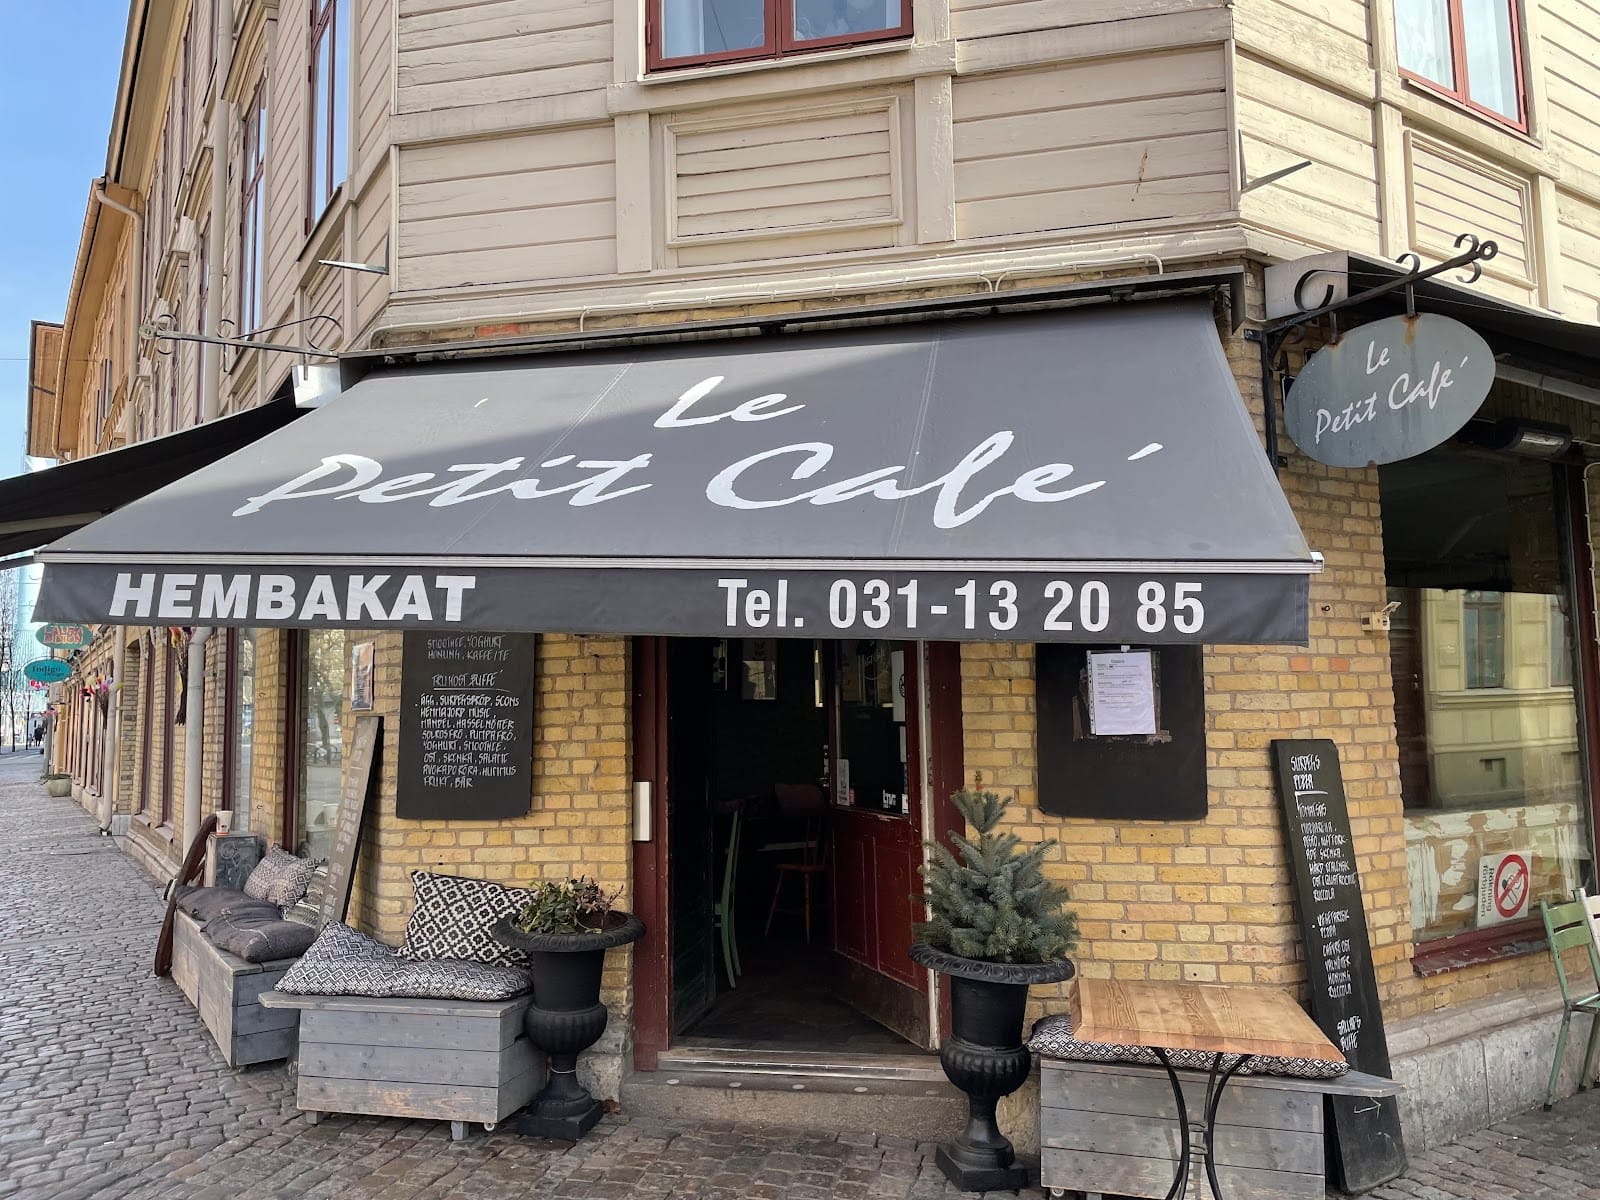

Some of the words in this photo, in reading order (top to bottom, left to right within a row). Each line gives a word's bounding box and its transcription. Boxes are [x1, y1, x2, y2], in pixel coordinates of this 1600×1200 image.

[1366, 340, 1390, 375] Le
[654, 375, 806, 428] Le
[1315, 392, 1377, 445] Petit
[1388, 355, 1469, 410] Café
[232, 453, 653, 517] Petit
[705, 430, 1163, 529] Café
[108, 572, 476, 622] HEMBAKAT
[717, 578, 804, 629] Tel.
[828, 578, 1020, 630] 031-13
[1042, 580, 1111, 633] 20
[1135, 581, 1205, 634] 85
[495, 694, 520, 707] SCONS
